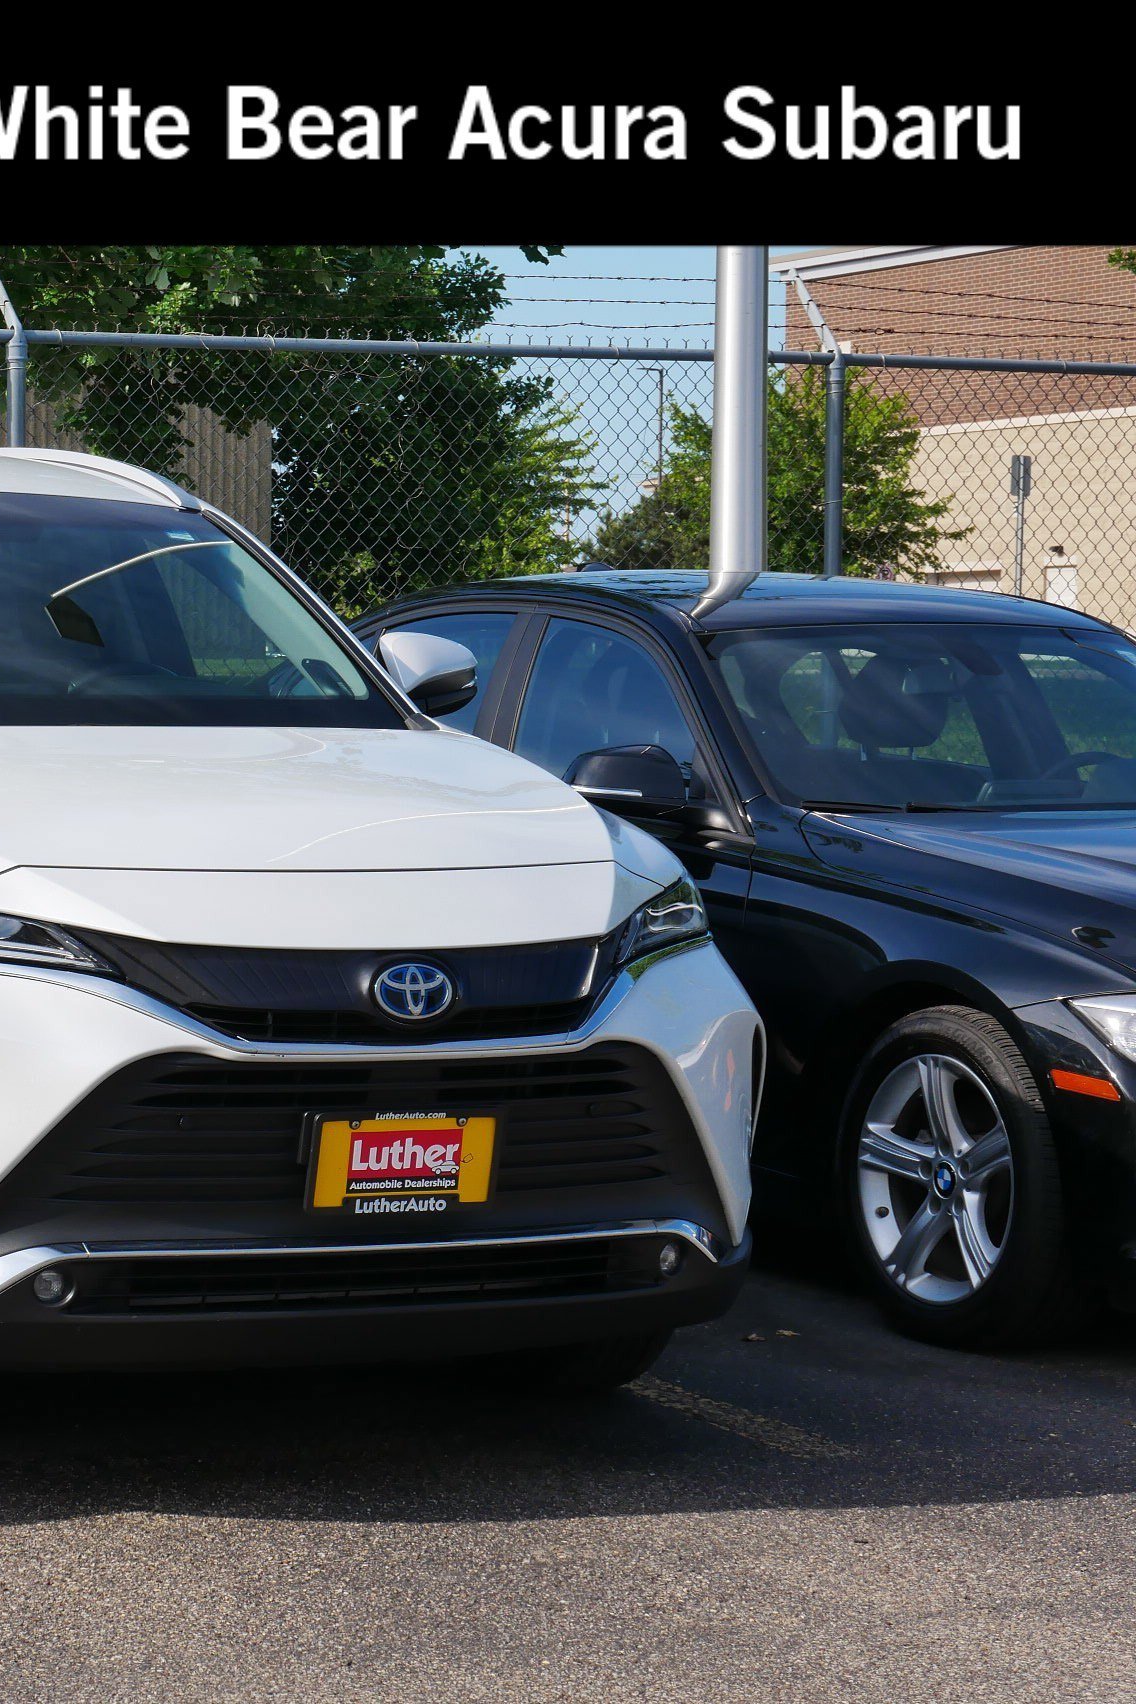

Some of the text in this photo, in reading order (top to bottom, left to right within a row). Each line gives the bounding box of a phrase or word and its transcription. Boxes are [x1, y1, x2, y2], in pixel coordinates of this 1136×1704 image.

[375, 1111, 447, 1121] LutherAuto.com
[351, 1137, 460, 1171] Luther
[349, 1178, 456, 1190] Automobile Dealerships
[354, 1196, 447, 1214] LutherAuto
